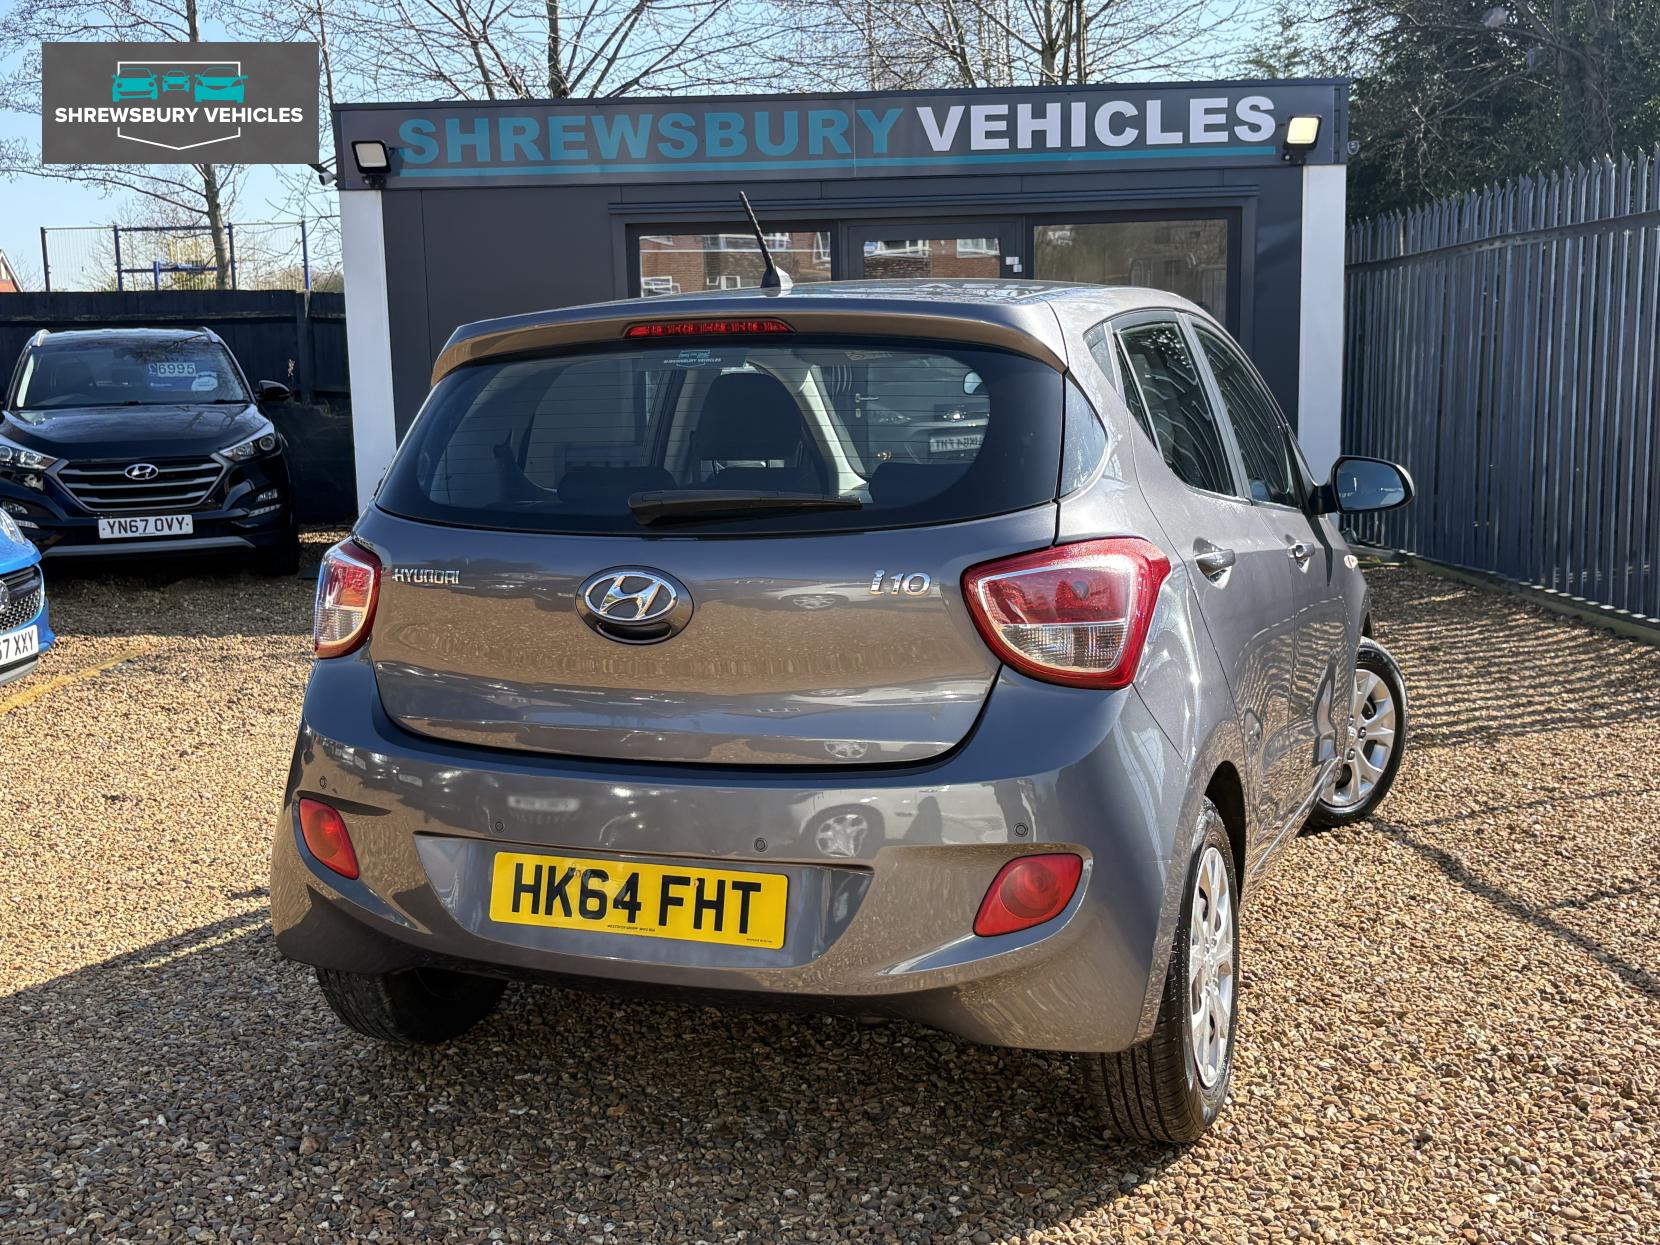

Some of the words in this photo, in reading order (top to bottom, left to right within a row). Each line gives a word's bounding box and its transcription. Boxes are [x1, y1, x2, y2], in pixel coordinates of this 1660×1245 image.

[399, 107, 904, 165] SHREWSBURY
[916, 95, 1276, 152] VEHICLES
[107, 519, 149, 535] YN67
[154, 517, 185, 532] OVY
[392, 568, 460, 585] HYUNDAI
[870, 569, 931, 596] i10
[0, 638, 10, 660] 7
[13, 630, 34, 656] XXY
[511, 863, 643, 924] HK64
[658, 874, 762, 934] FHT
